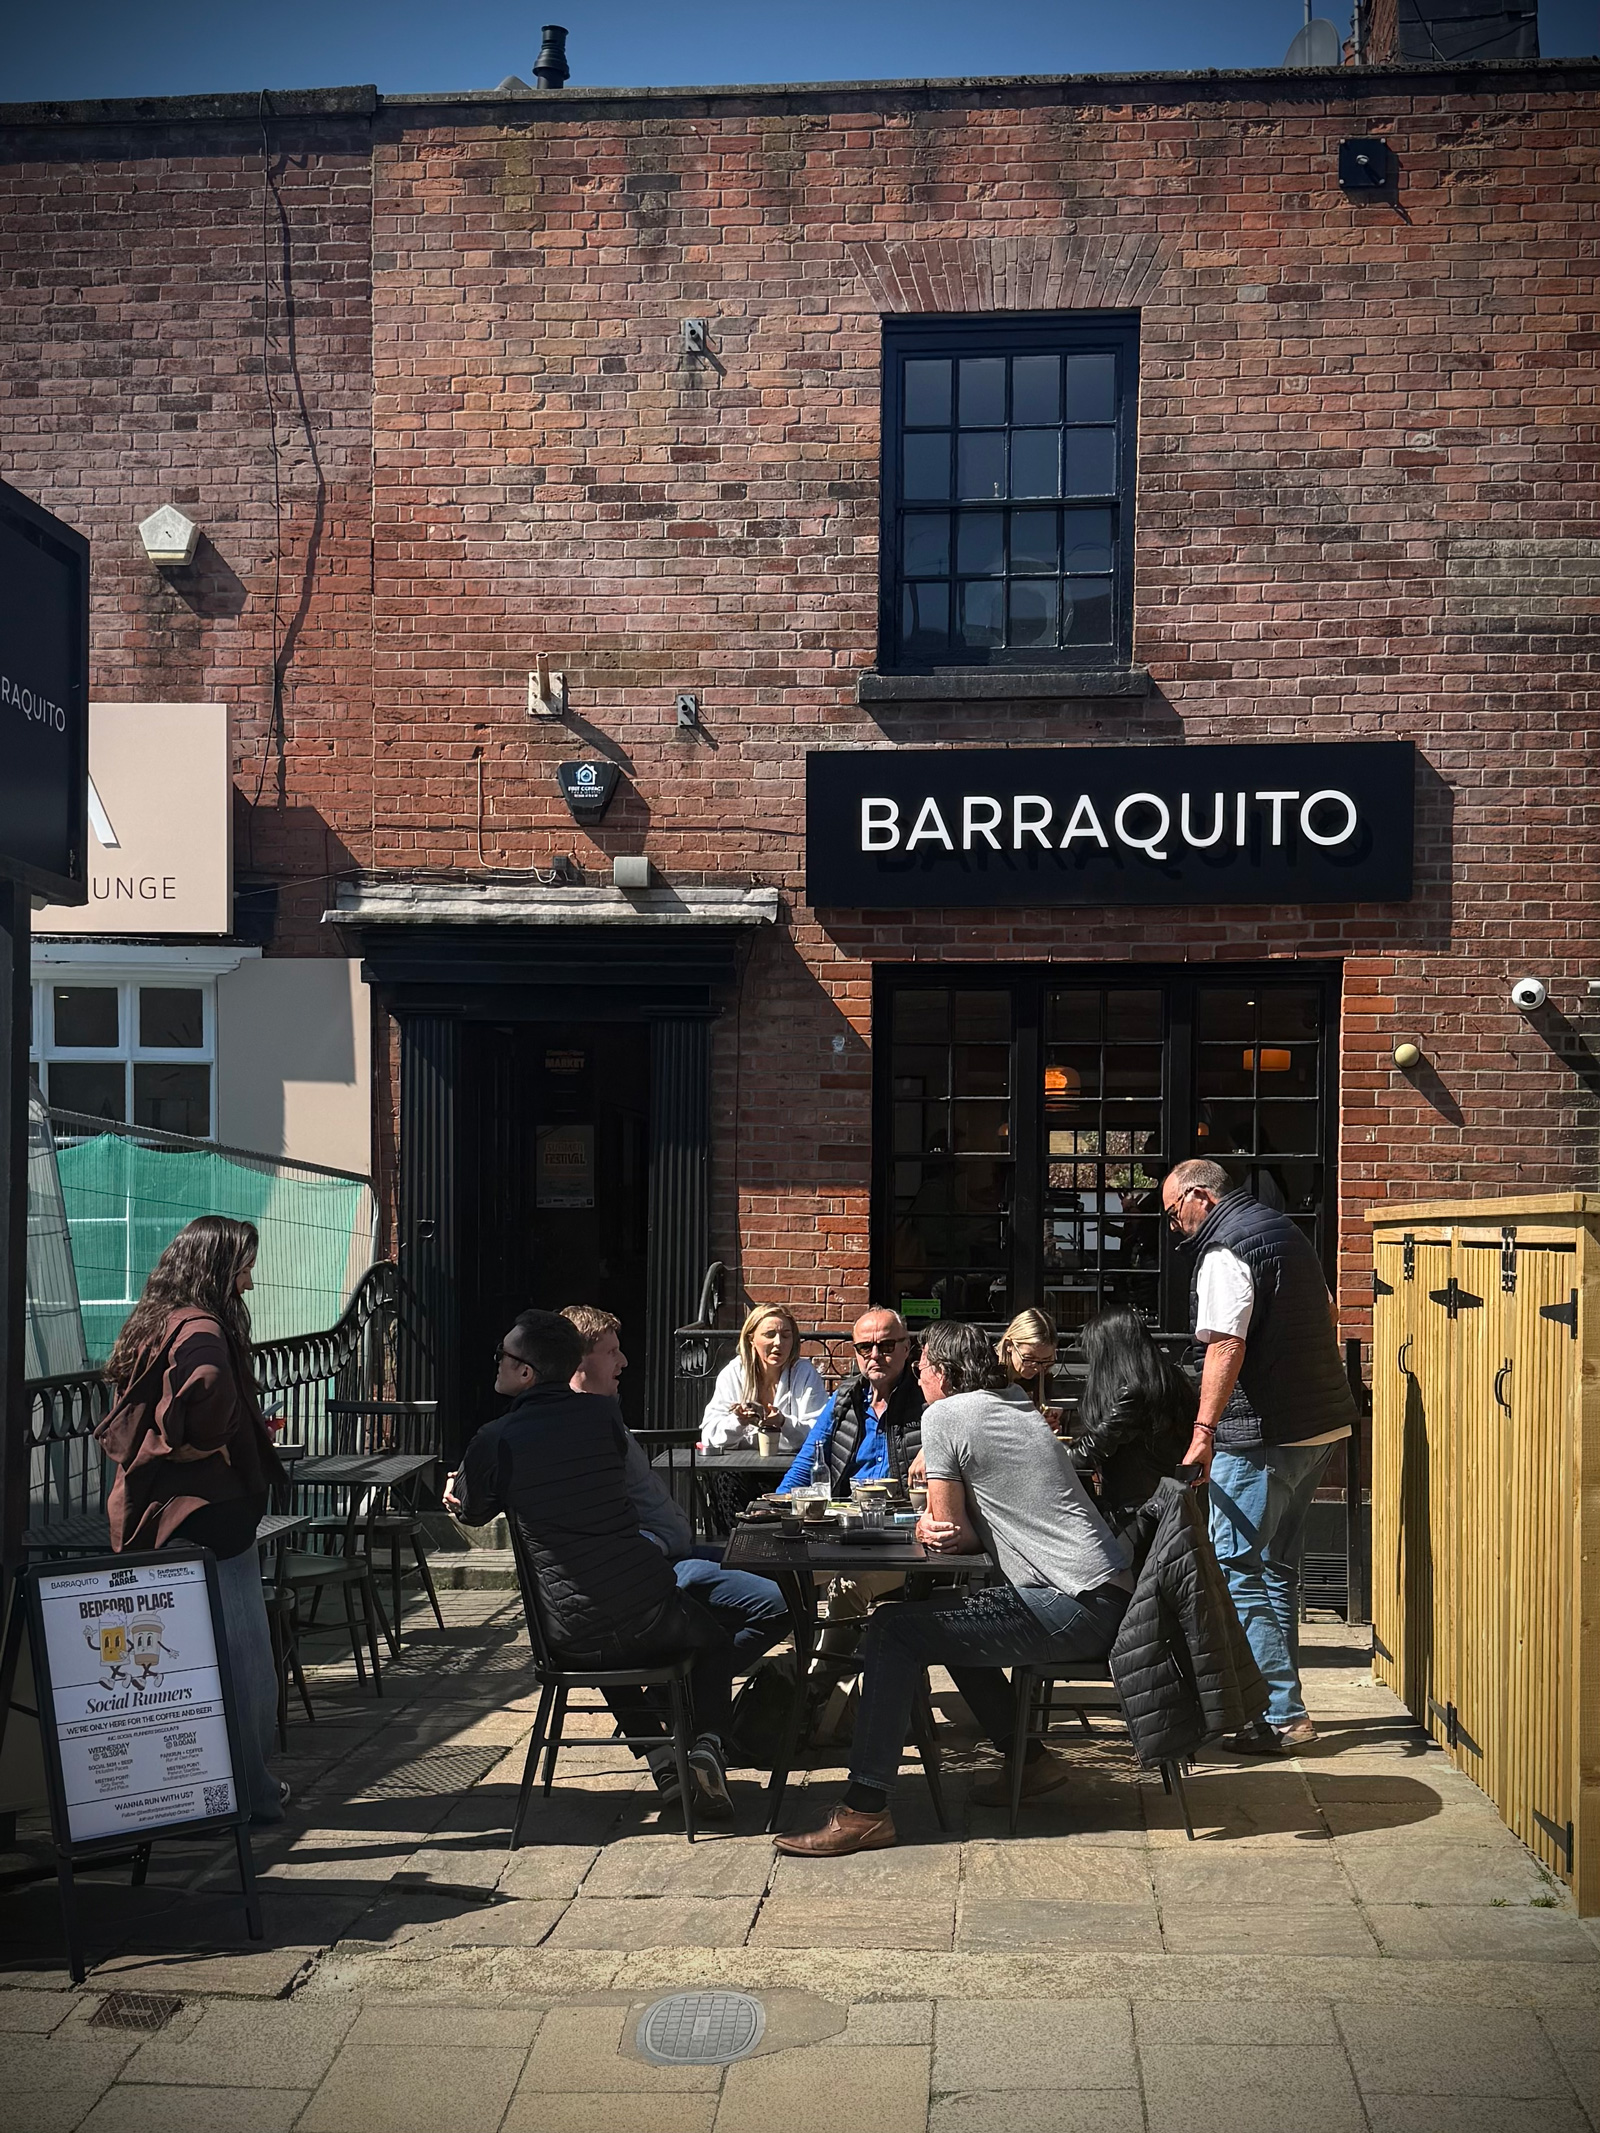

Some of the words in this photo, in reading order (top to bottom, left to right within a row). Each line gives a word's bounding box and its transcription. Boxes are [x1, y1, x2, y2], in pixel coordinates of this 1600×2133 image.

[861, 789, 1357, 860] BARRAQUITO
[545, 1153, 585, 1164] FESTIVAL
[111, 1569, 134, 1580] DIRTY
[51, 1577, 99, 1590] BARRAQUITO
[109, 1575, 139, 1588] BARREL
[79, 1596, 135, 1619] BEDFORD
[136, 1591, 175, 1612] PLACE
[85, 1693, 129, 1715] Social
[132, 1687, 193, 1707] Runners
[89, 1722, 108, 1732] ONLY
[109, 1720, 126, 1729] HERE
[127, 1717, 141, 1726] FOR
[142, 1714, 156, 1724] THE
[155, 1711, 181, 1721] COFFEE
[181, 1709, 195, 1718] AND
[196, 1706, 213, 1715] BEER
[163, 1731, 197, 1743] SATURDAY
[88, 1742, 130, 1755] WEDNESDAY
[114, 1801, 145, 1811] WANNA
[144, 1797, 160, 1806] RUN
[160, 1794, 179, 1804] WITH
[180, 1791, 194, 1799] US?
